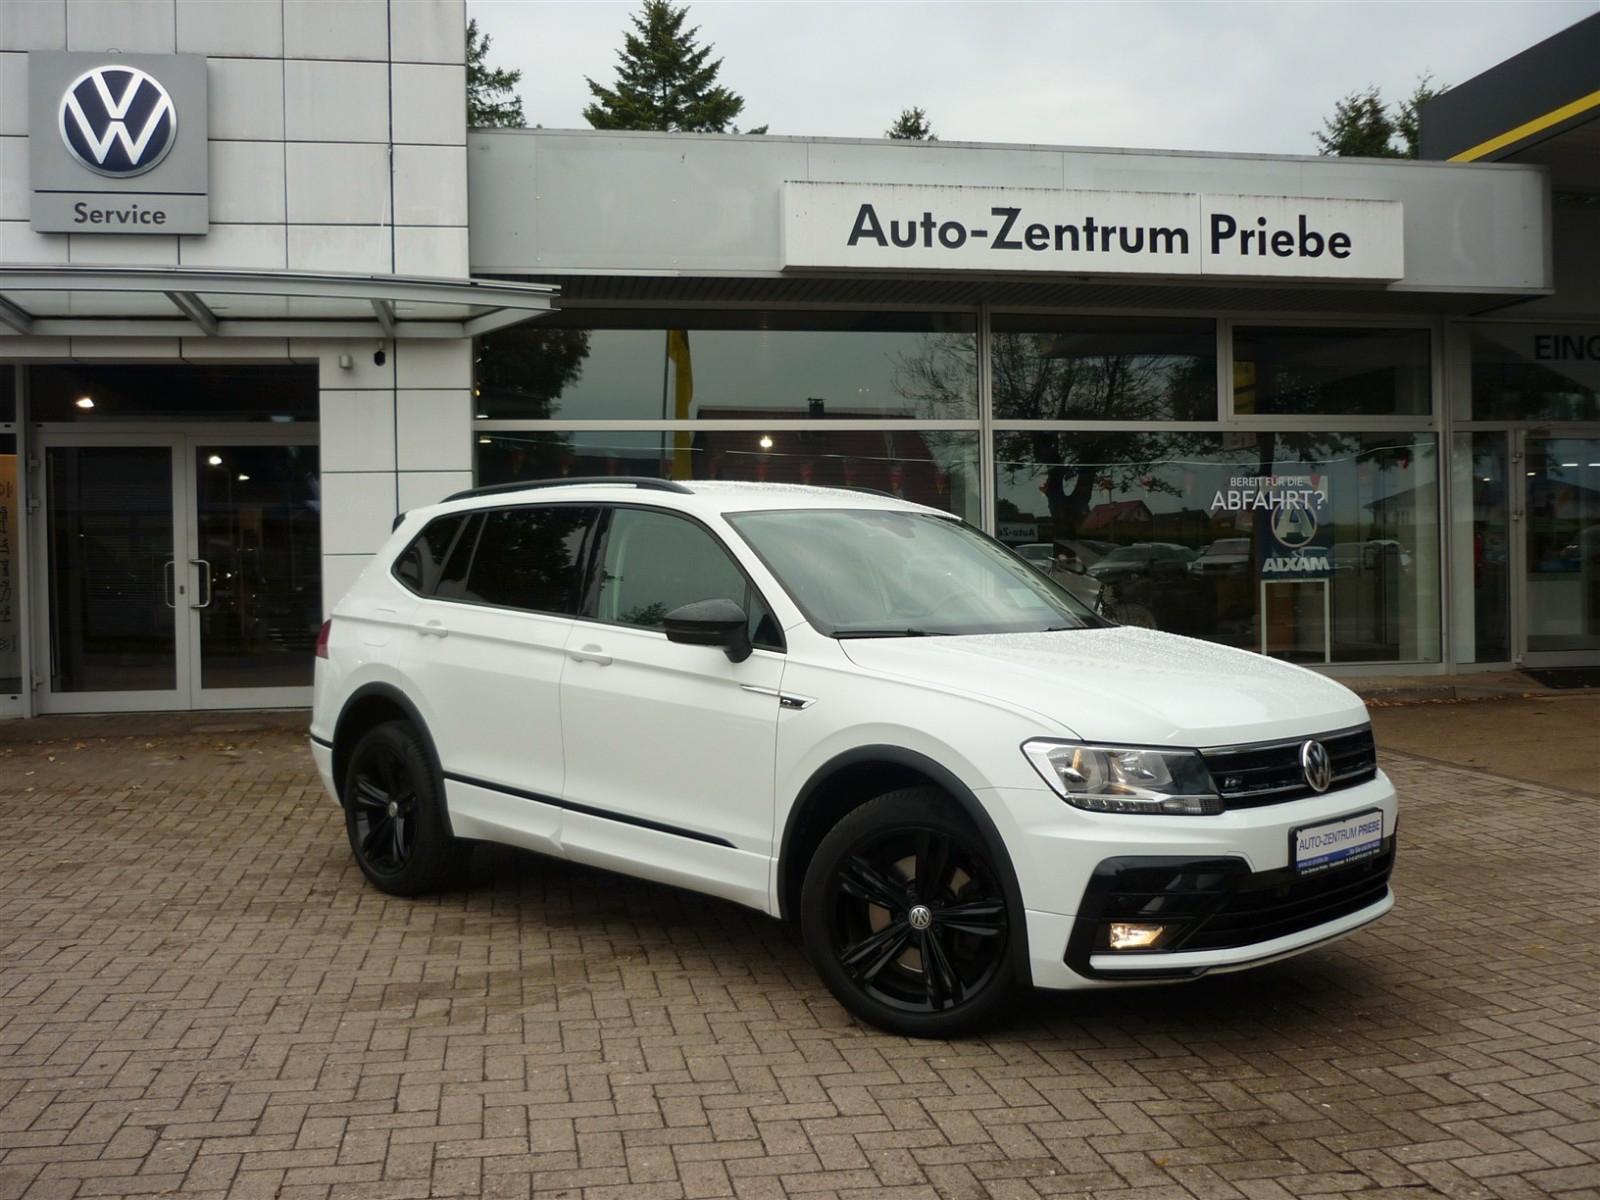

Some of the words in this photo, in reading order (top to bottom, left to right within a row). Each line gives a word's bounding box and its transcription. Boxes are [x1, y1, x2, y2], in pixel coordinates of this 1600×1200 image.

[73, 202, 167, 226] Service
[847, 203, 1190, 255] Auto-Zentrum
[1209, 213, 1353, 260] Priebe
[1230, 476, 1262, 487] BEREIT
[1265, 475, 1285, 487] FÜR
[1287, 476, 1304, 487] DIE
[1210, 490, 1325, 511] ABFAHRT?
[1262, 556, 1331, 573] AIXAM
[1298, 826, 1357, 852] AUTO-ZENTRUM
[1358, 819, 1381, 837] PRIEBE
